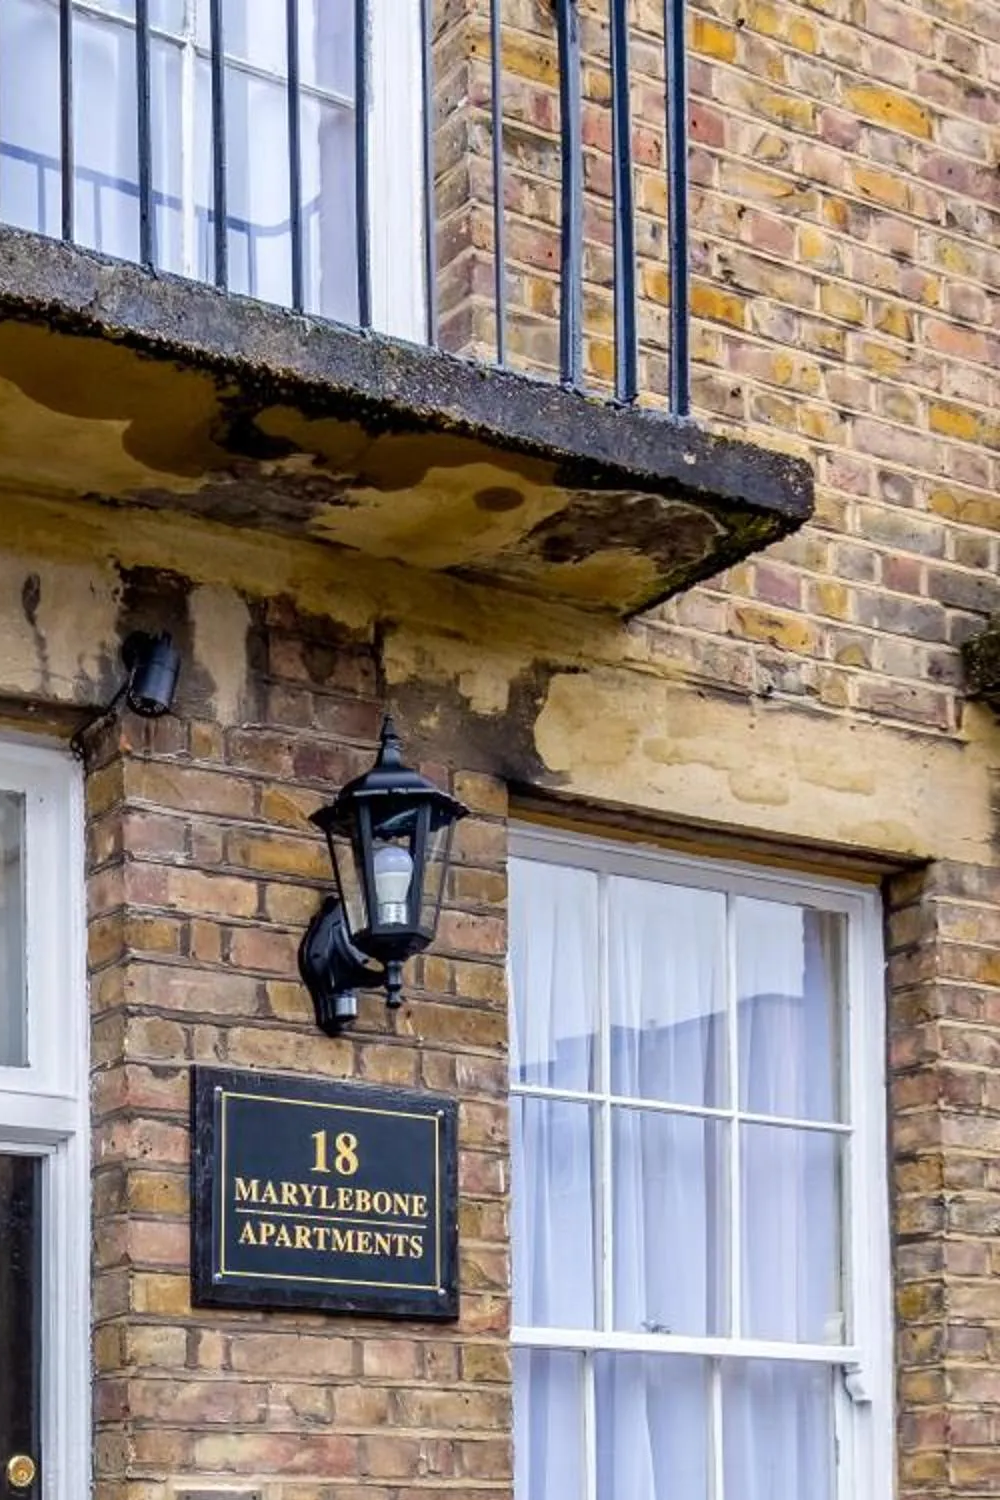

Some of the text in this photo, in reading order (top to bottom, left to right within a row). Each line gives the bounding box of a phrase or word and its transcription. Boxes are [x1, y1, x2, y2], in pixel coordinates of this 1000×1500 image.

[310, 1129, 359, 1176] 18
[234, 1176, 429, 1218] MARYLEBONE
[238, 1221, 424, 1259] APARTMENTS
